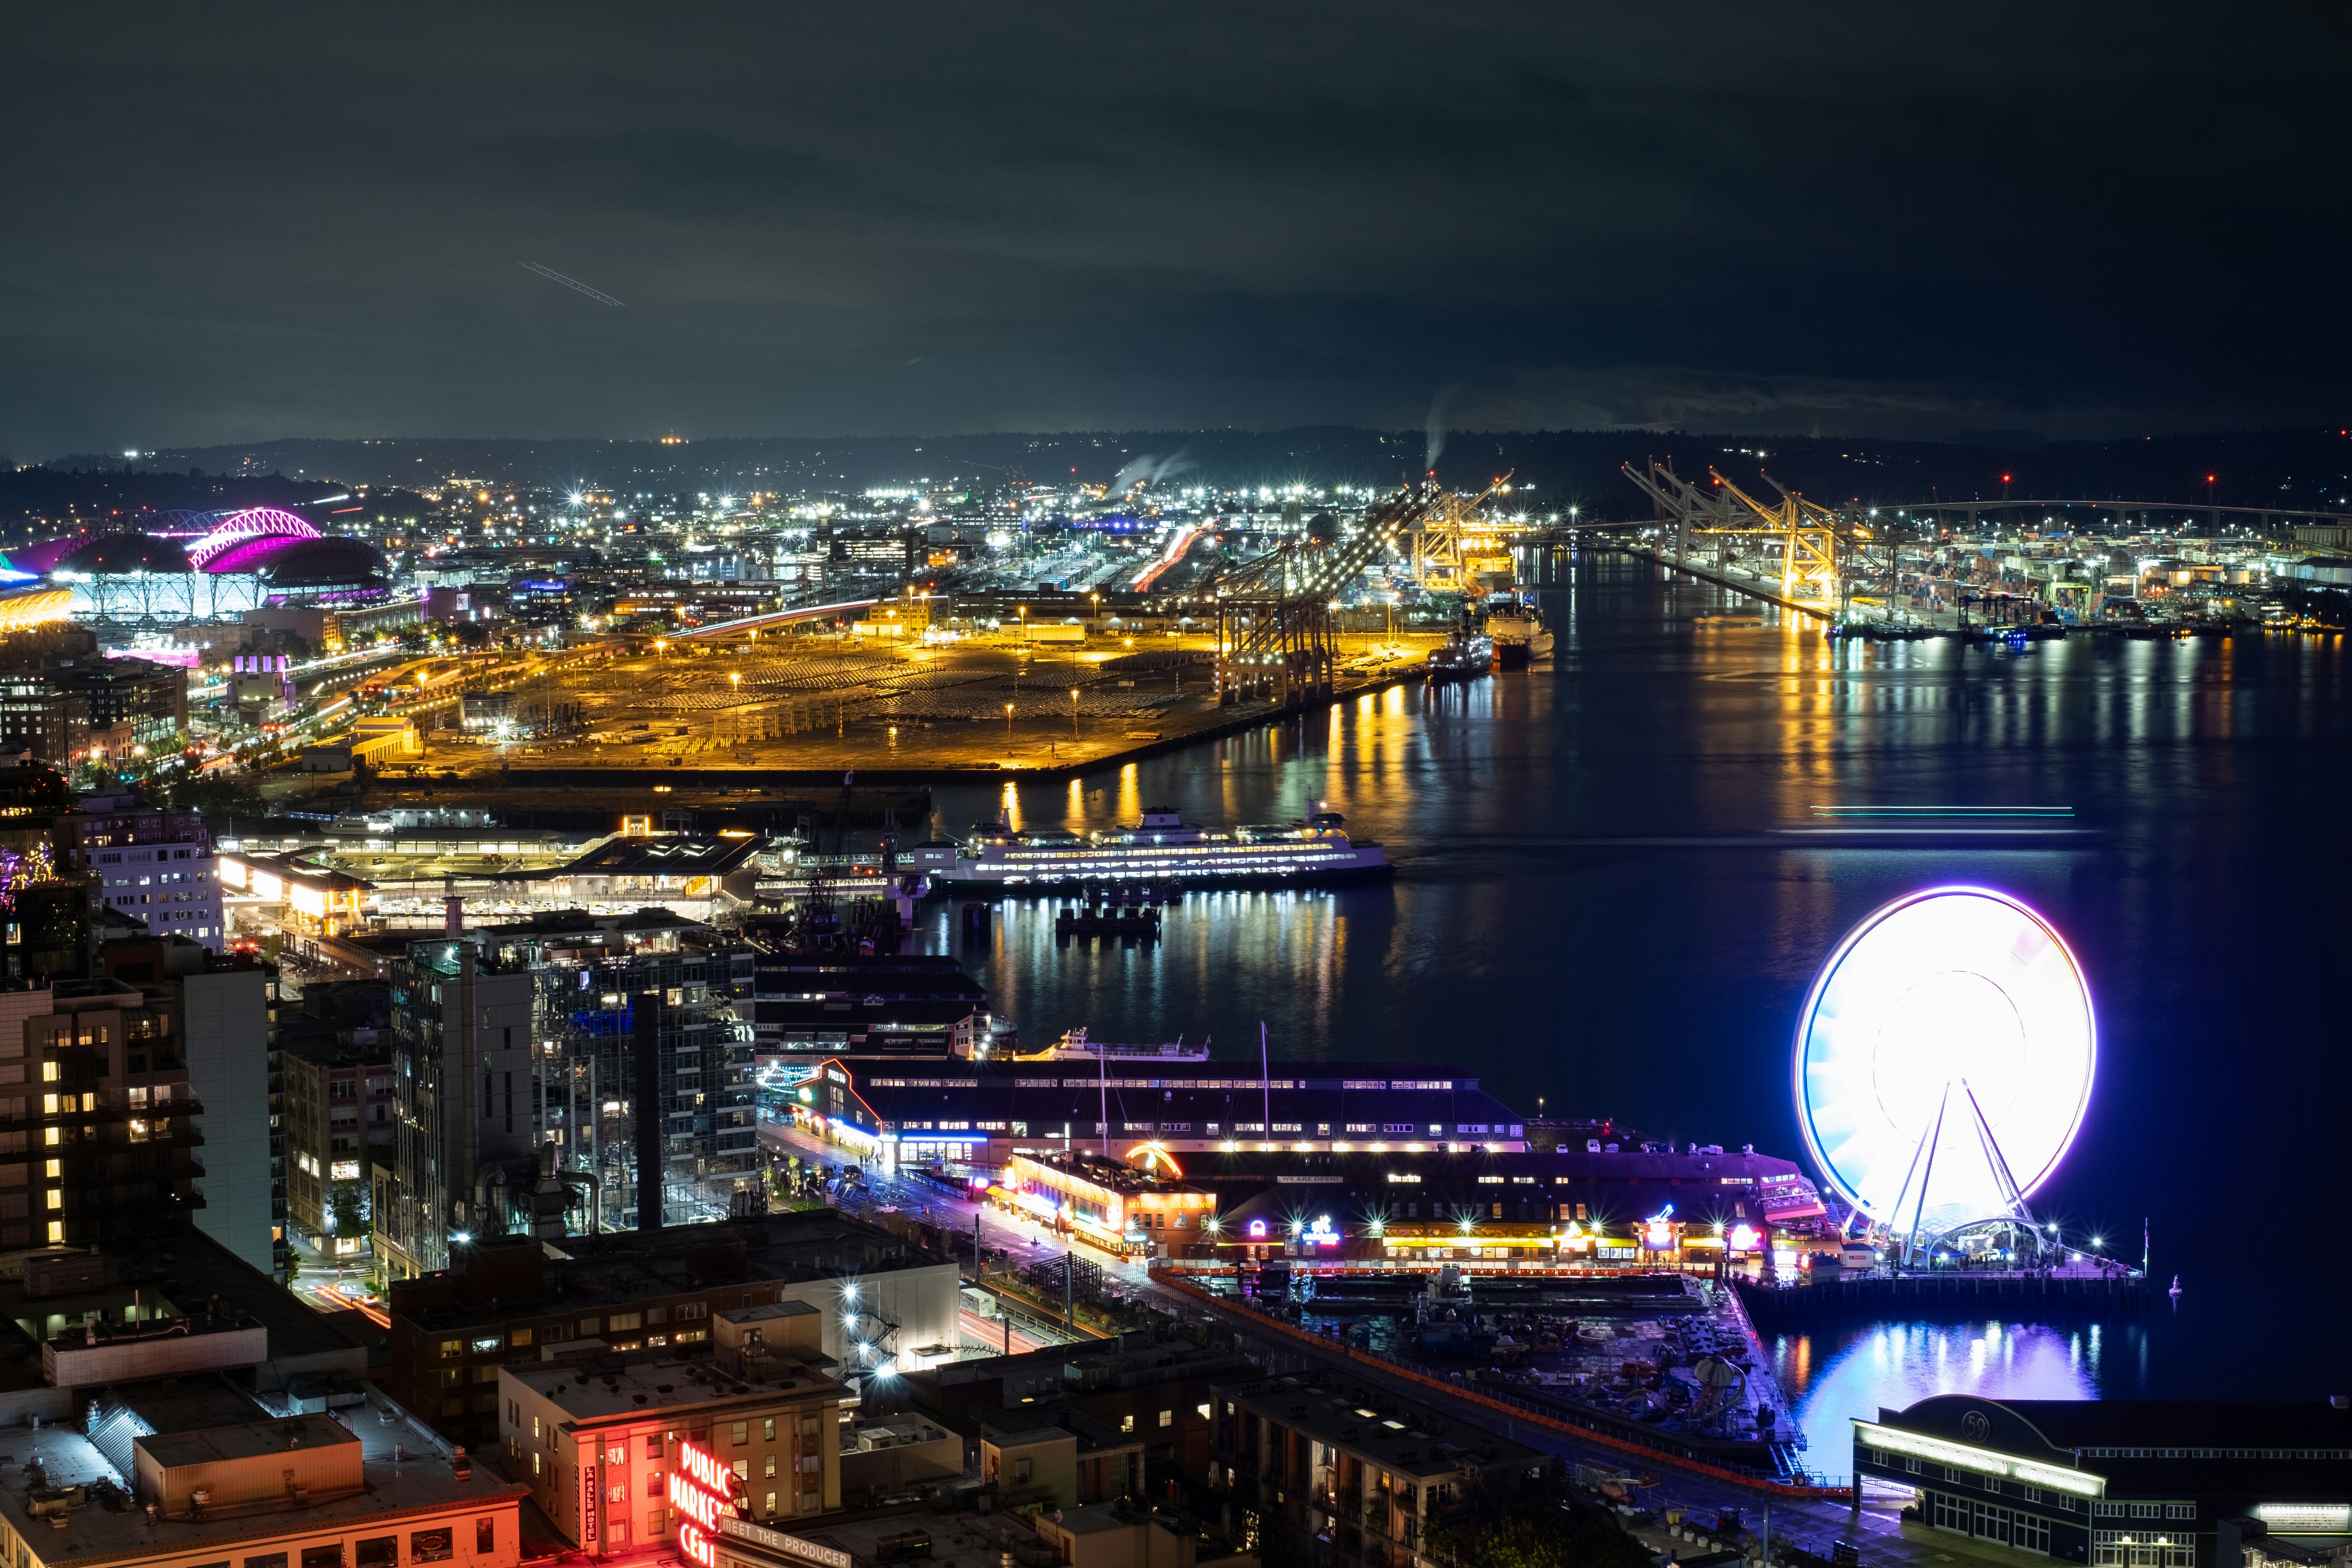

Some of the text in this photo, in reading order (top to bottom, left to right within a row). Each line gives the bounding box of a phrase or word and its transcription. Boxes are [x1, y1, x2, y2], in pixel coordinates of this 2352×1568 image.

[1969, 1416, 1985, 1438] 59
[586, 1467, 594, 1479] LA
[683, 1442, 731, 1497] PUBLIC
[670, 1473, 723, 1530] MARKET
[587, 1511, 595, 1540] HOTEL
[723, 1518, 847, 1568] MEET THE PRODUCER
